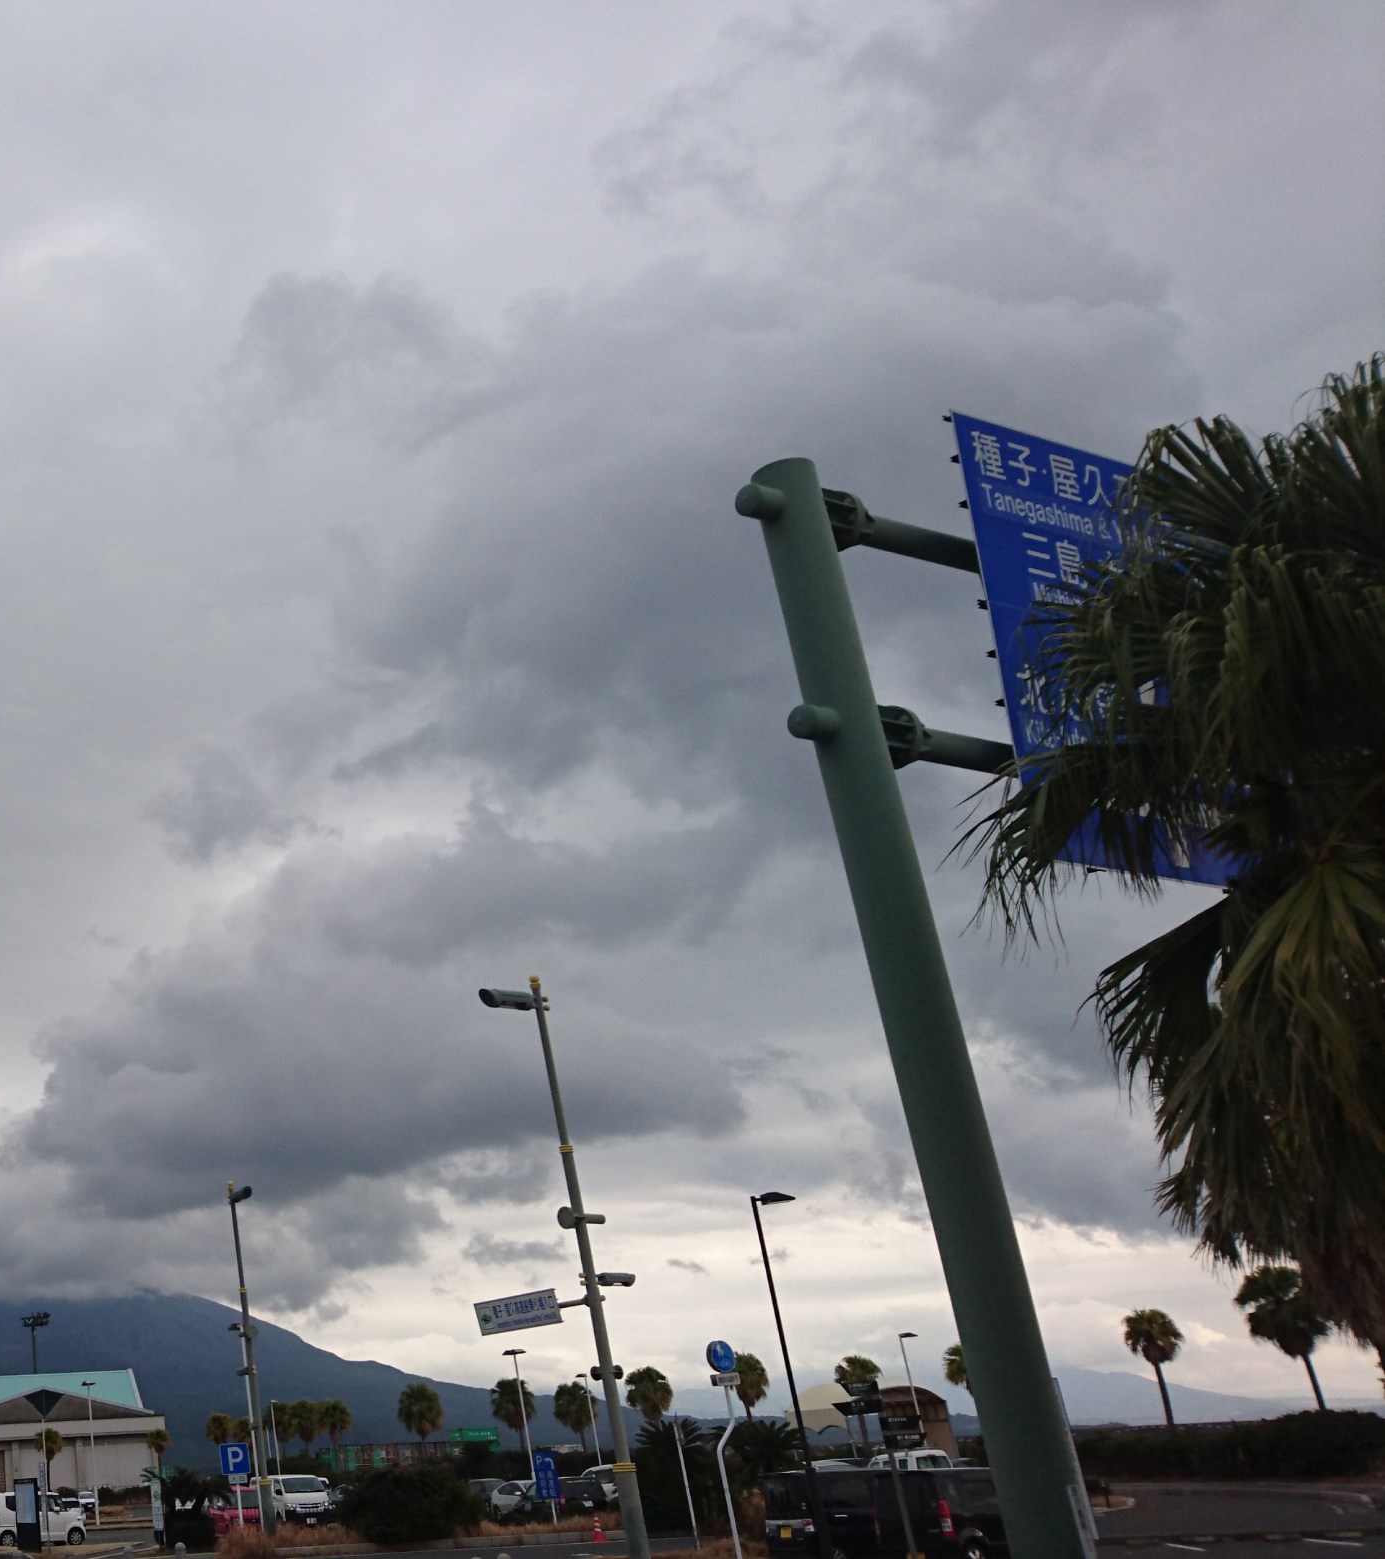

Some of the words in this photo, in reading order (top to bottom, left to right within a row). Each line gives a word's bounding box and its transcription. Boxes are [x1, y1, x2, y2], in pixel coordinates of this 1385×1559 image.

[971, 430, 1138, 513] 種子・屋久
[980, 482, 1094, 536] Tanegashima
[1098, 516, 1112, 540] &
[227, 1446, 244, 1472] P
[536, 1455, 542, 1466] P
